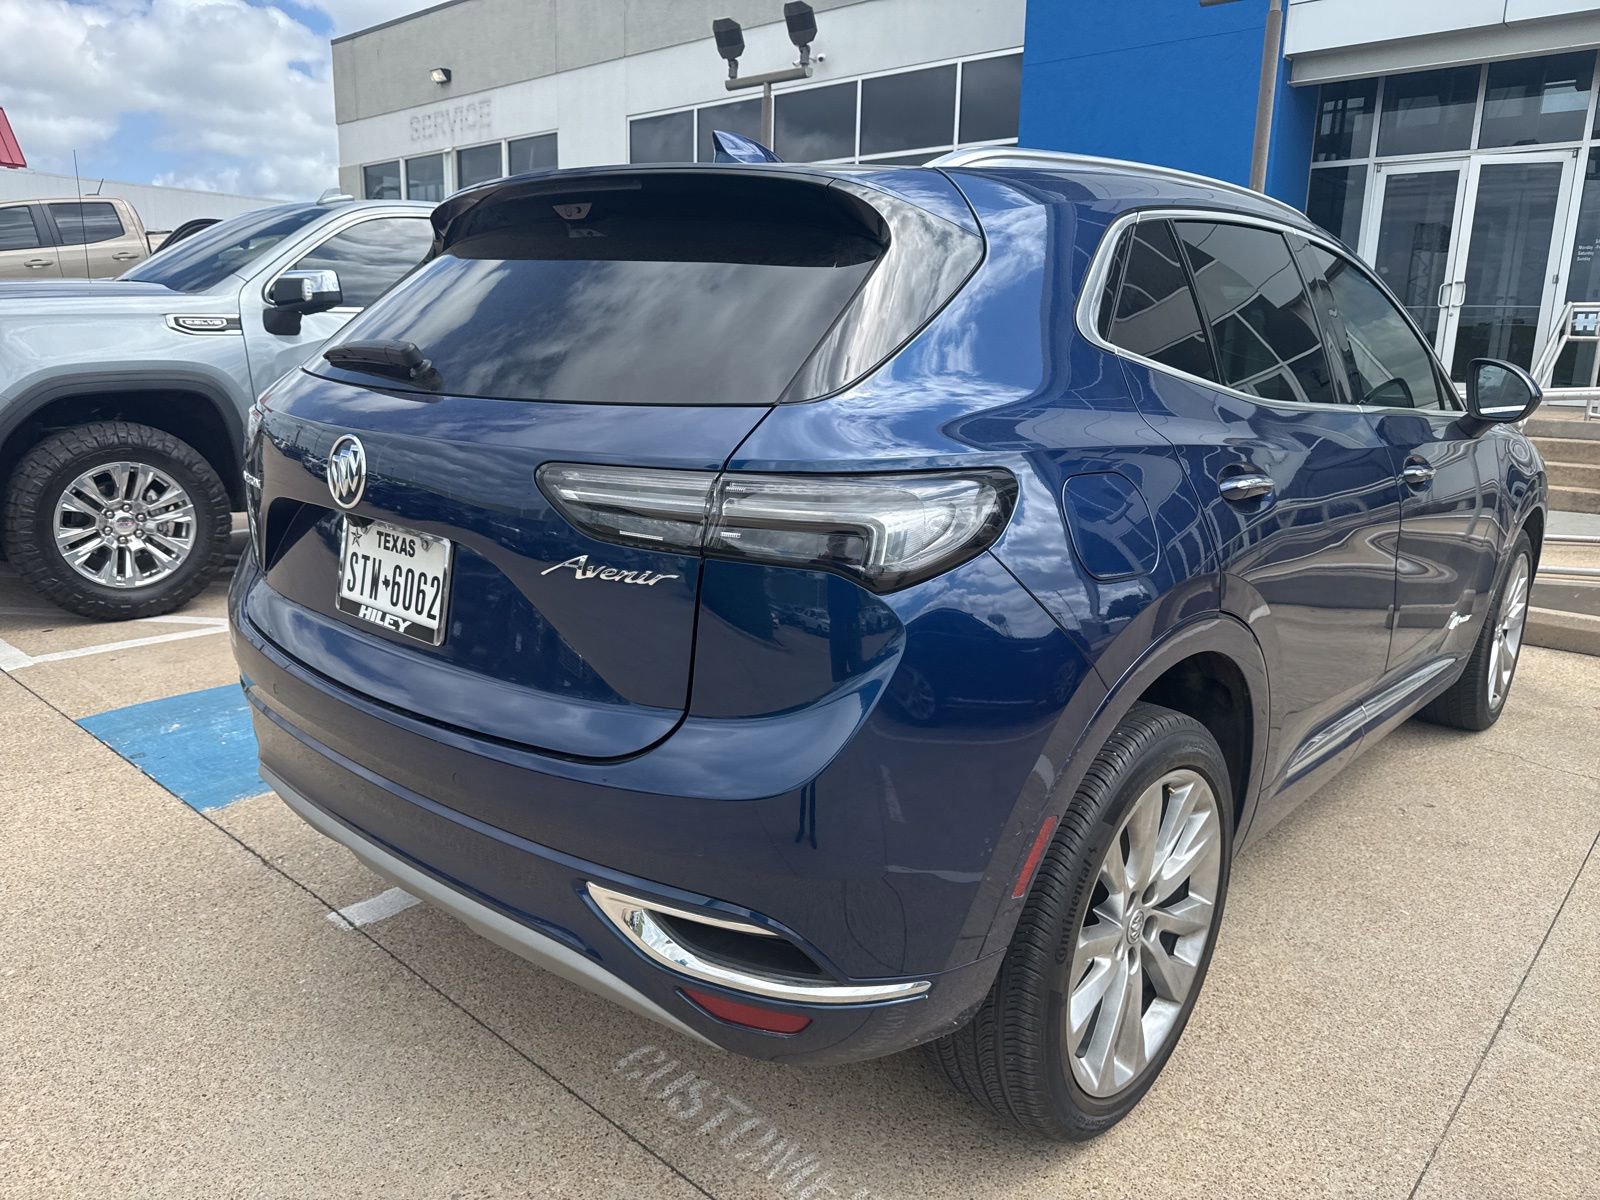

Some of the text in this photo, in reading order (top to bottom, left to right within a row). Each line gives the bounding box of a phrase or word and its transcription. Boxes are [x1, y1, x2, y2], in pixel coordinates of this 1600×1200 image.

[409, 98, 491, 142] SERVICE
[377, 531, 416, 557] TEXAS
[540, 554, 680, 586] Avenir
[359, 605, 412, 632] HILEY
[1055, 858, 1092, 966] Continental
